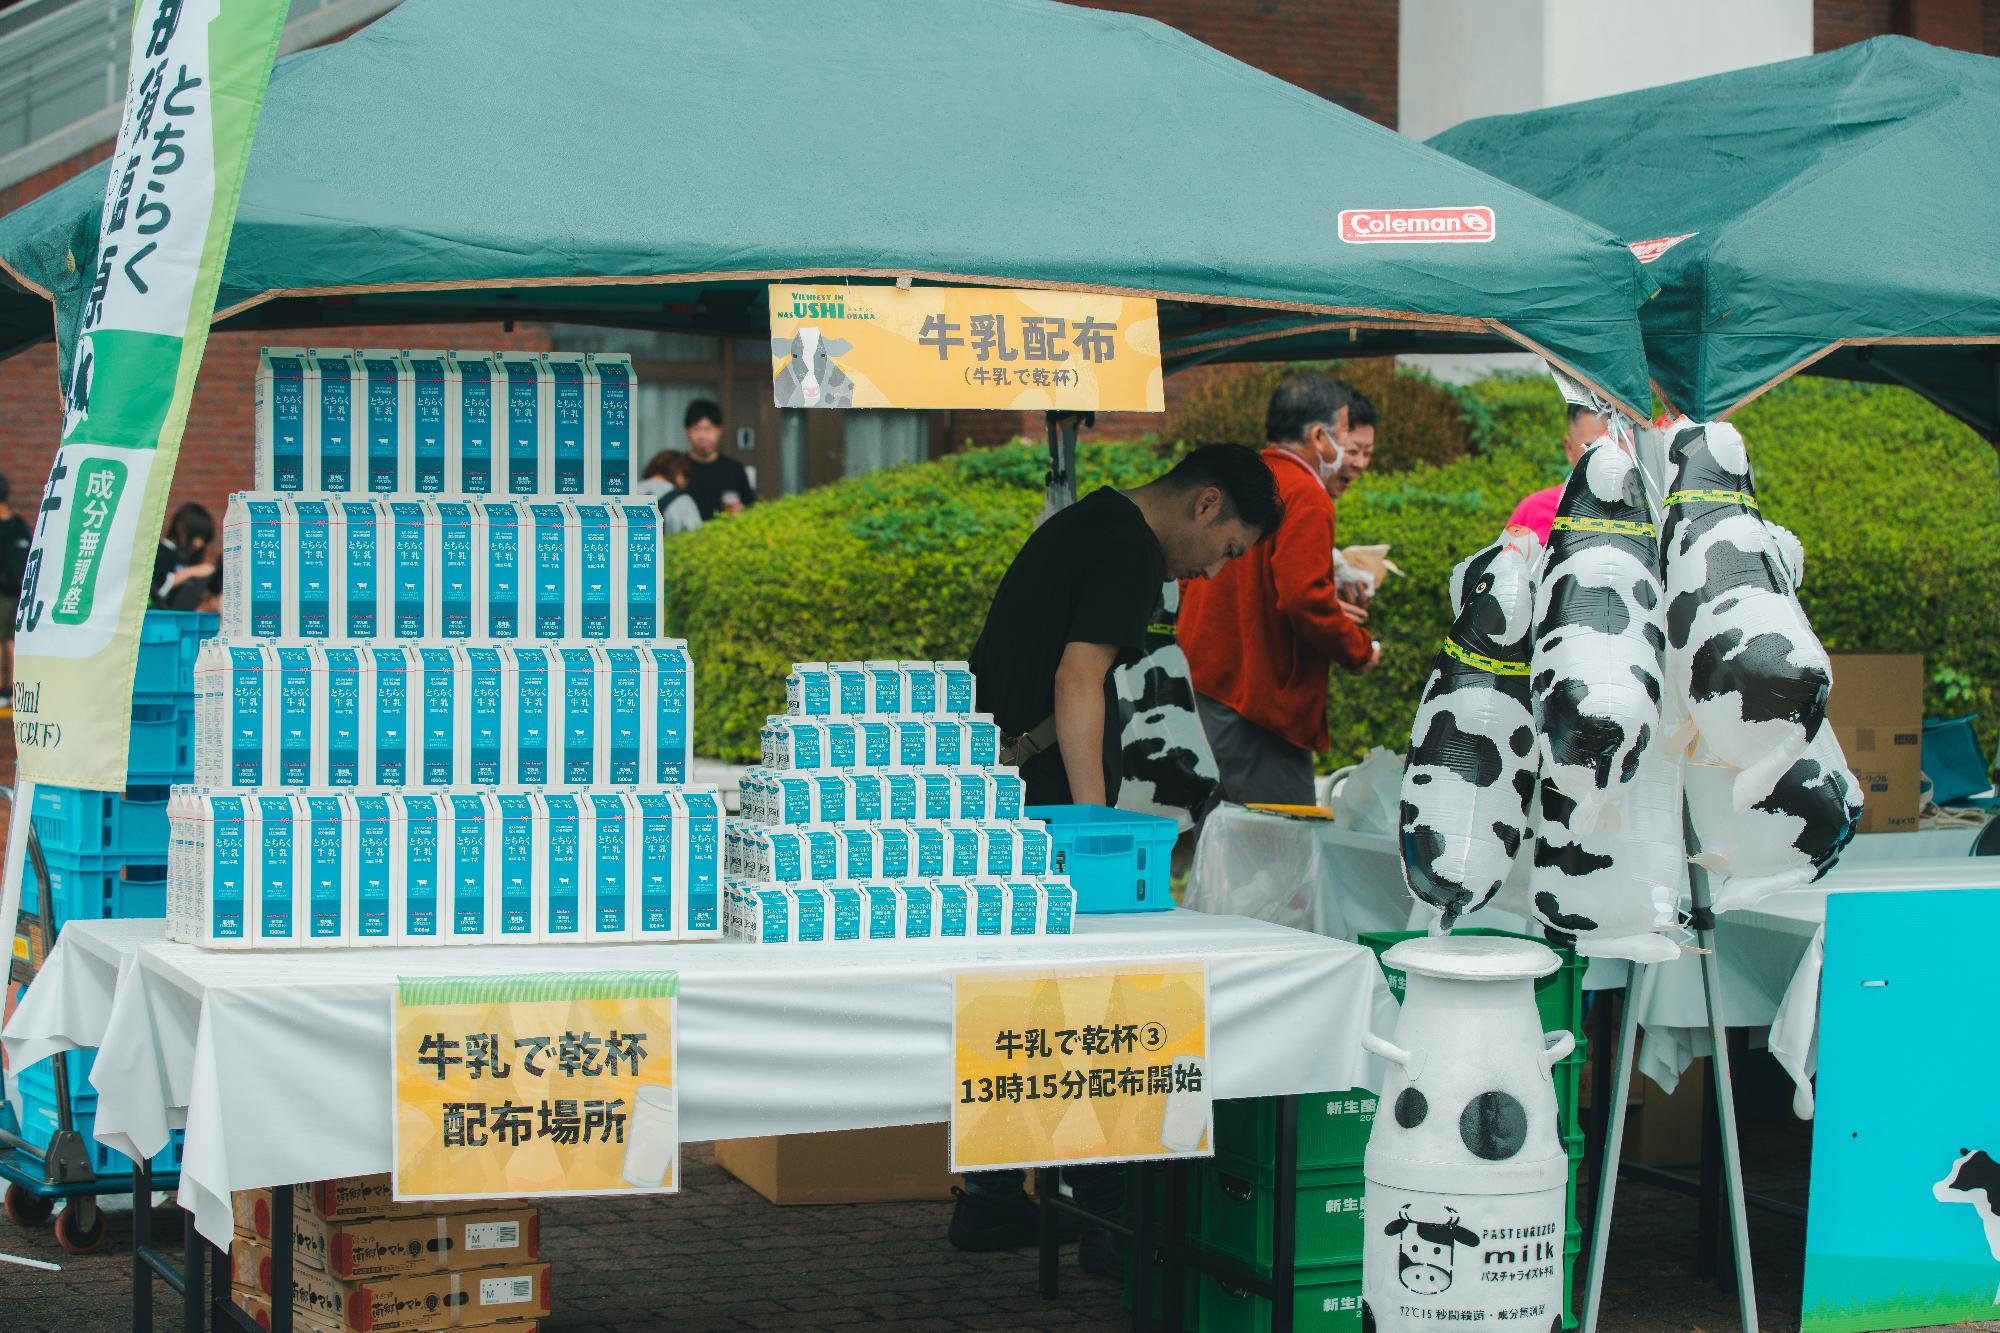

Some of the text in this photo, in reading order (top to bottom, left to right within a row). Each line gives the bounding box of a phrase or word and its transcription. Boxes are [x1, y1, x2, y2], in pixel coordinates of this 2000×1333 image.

[124, 65, 202, 294] とちらく
[1350, 213, 1462, 234] Coleman
[918, 313, 1117, 364] 牛乳配布
[964, 367, 1079, 388] (牛乳で乾杯)
[60, 470, 116, 615] 成分無調整
[417, 1030, 648, 1080] 牛乳で乾杯
[994, 1021, 1168, 1059] 牛乳で乾杯③
[960, 1063, 1203, 1104] 13時15分配布開始
[442, 1098, 627, 1148] 配布場所
[471, 1234, 480, 1244] M
[1482, 1223, 1556, 1240] PASTEURIZED
[1484, 1241, 1554, 1264] milk
[486, 1289, 495, 1299] M
